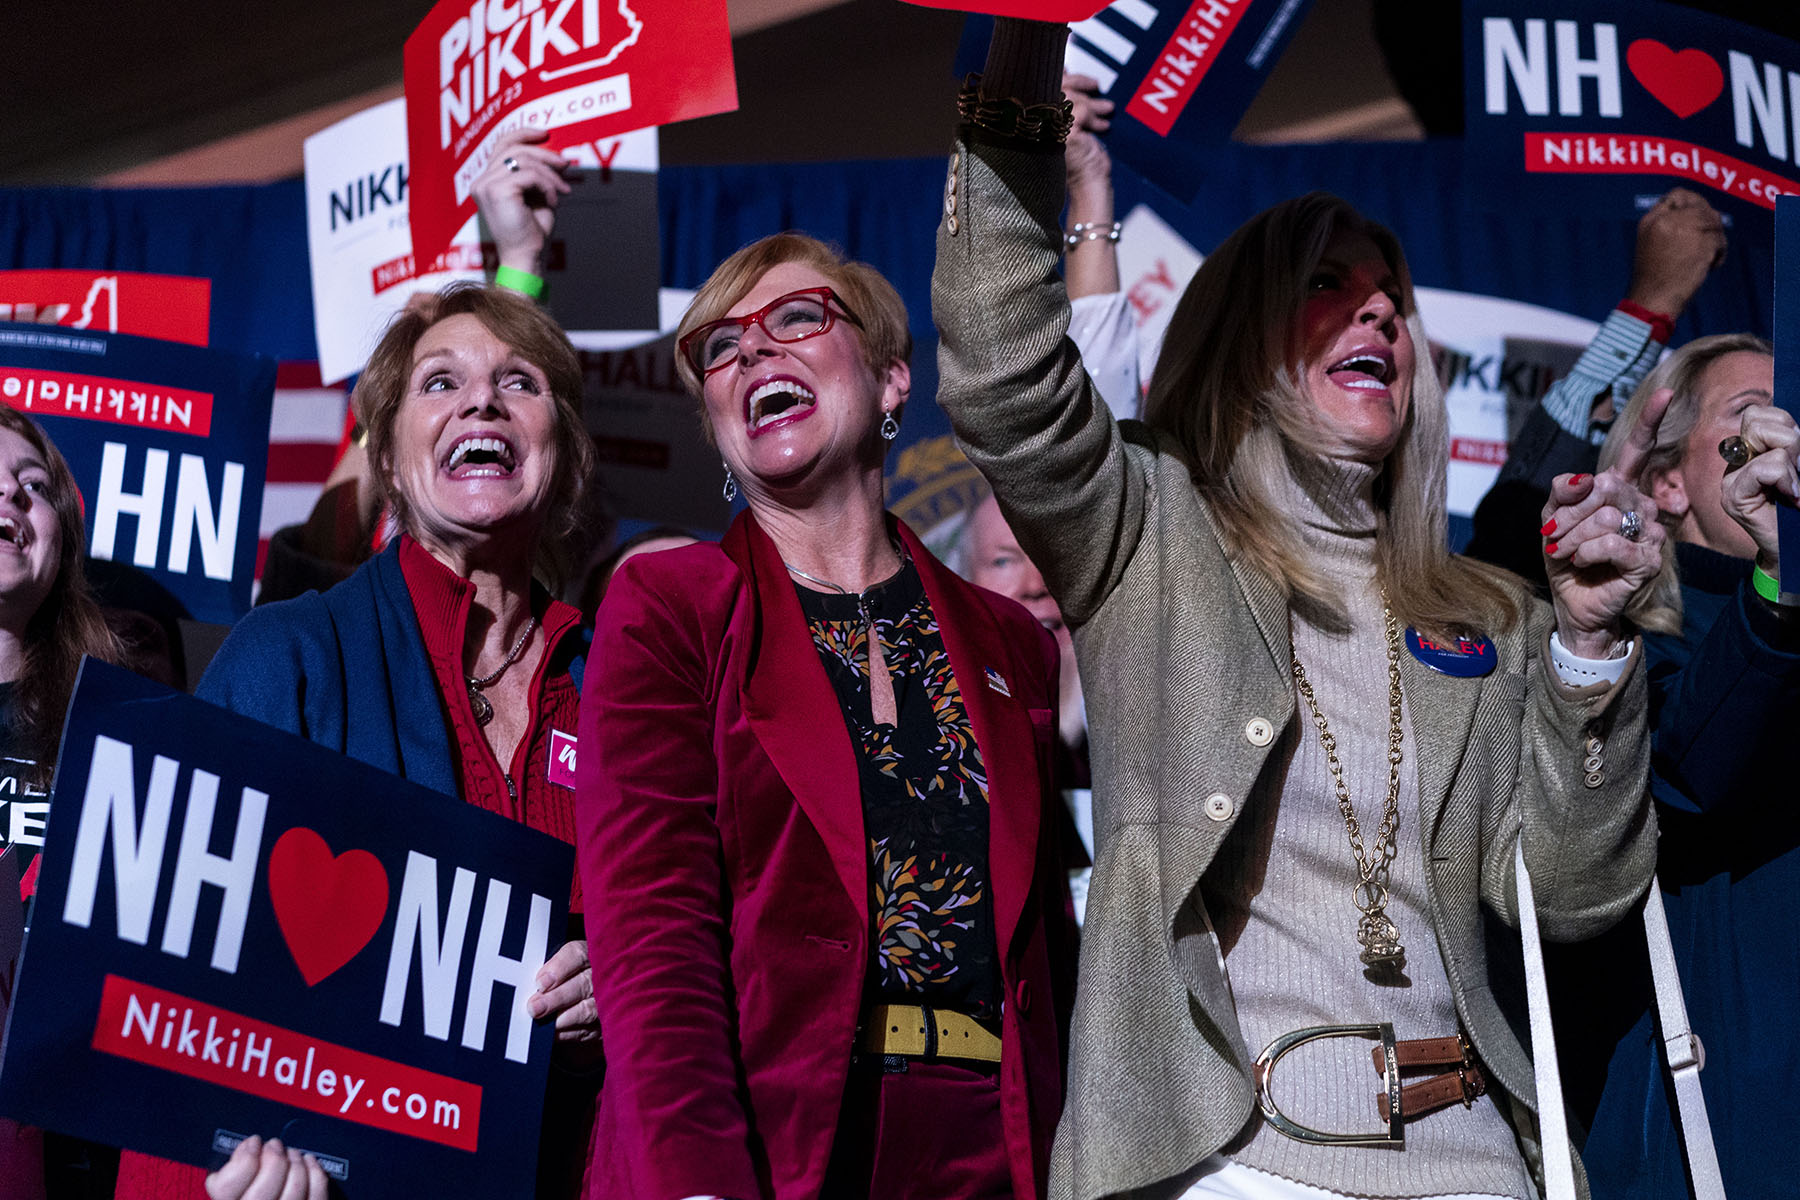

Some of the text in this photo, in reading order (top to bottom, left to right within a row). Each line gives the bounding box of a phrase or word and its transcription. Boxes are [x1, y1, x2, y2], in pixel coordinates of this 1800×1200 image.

[440, 0, 545, 90] PIC
[440, 0, 600, 150] NIKKI
[1142, 0, 1242, 114] NikkiH
[1482, 17, 1623, 118] NH
[503, 81, 523, 105] 23
[1543, 136, 1800, 203] NikkiHaley.co
[1127, 257, 1176, 327] EY
[90, 440, 245, 582] NH
[1417, 636, 1486, 656] HEY
[0, 799, 51, 847] E
[62, 734, 552, 1064] NH NH
[120, 993, 462, 1130] NikkiHaley.com
